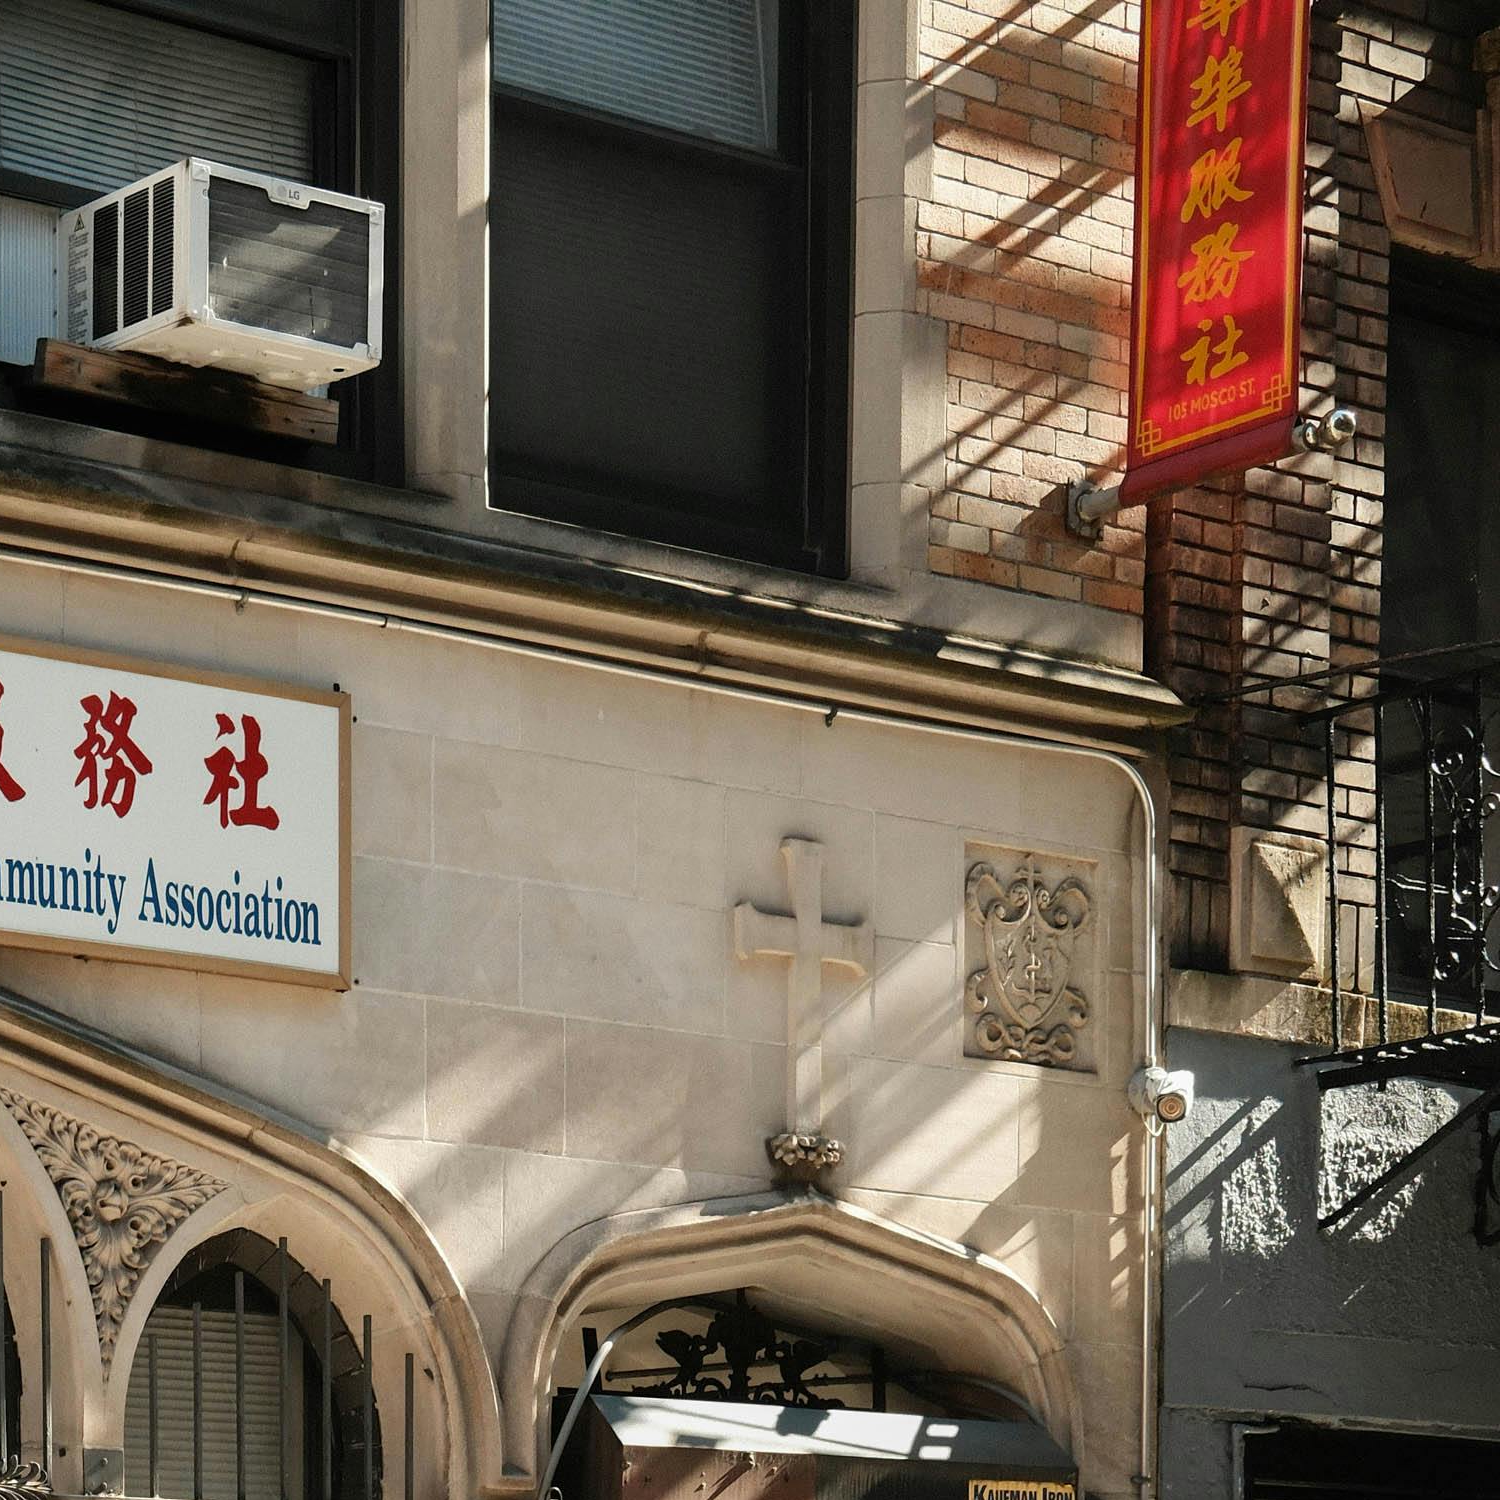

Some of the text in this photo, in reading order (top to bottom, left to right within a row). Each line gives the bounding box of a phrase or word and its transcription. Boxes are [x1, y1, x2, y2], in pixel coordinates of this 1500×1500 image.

[288, 189, 300, 201] LG
[1169, 377, 1256, 422] 105 MOSCO ST.
[138, 857, 321, 945] Association
